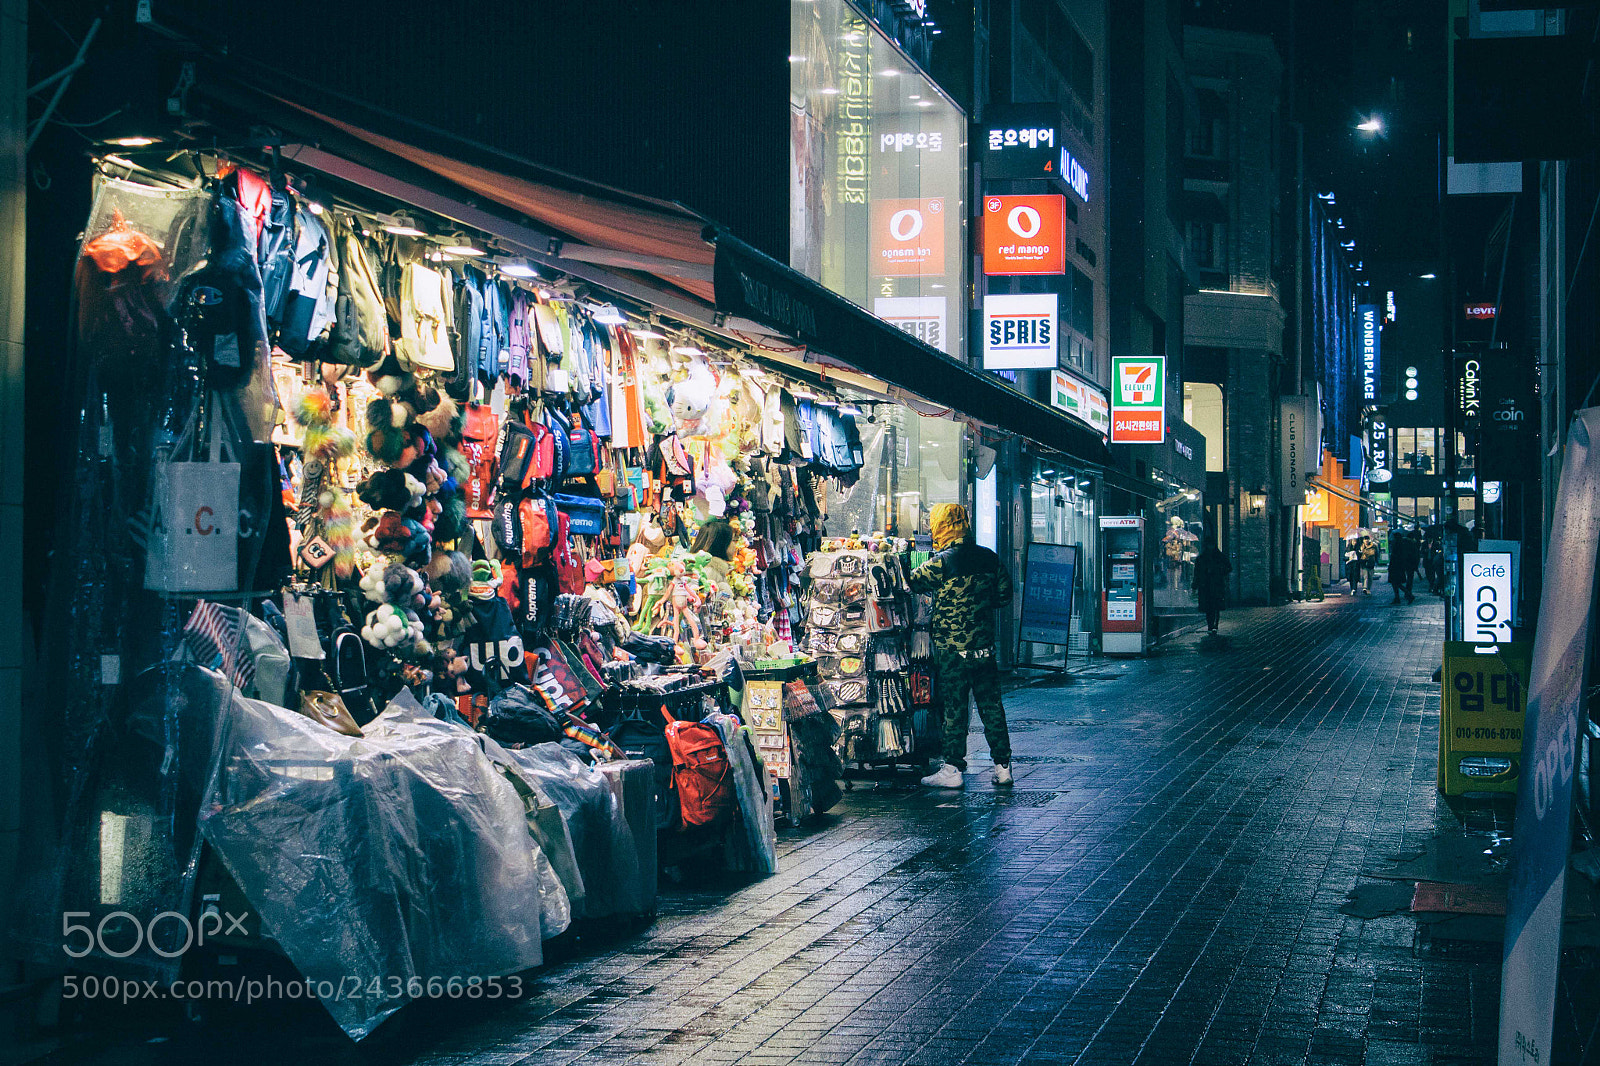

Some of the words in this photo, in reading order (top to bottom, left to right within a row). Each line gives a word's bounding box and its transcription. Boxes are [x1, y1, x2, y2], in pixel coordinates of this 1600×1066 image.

[988, 128, 1054, 150] 준오헤어
[1043, 160, 1053, 172] 4
[989, 201, 999, 209] 3F
[998, 244, 1015, 254] red
[1017, 245, 1049, 255] mango
[989, 319, 1050, 345] SPRIS
[1363, 311, 1374, 399] WONDERPLACE
[1124, 366, 1152, 401] 7
[1465, 360, 1480, 399] Calvin
[1115, 420, 1160, 431] 24시간편의점
[1493, 406, 1524, 421] coin
[553, 429, 564, 474] Suprem
[1289, 442, 1297, 488] MONACO
[502, 502, 514, 545] Supreme
[1470, 564, 1505, 578] Café
[526, 577, 539, 623] Supreme
[1454, 671, 1521, 712] 임대
[1456, 727, 1521, 740] 010-8706-8780
